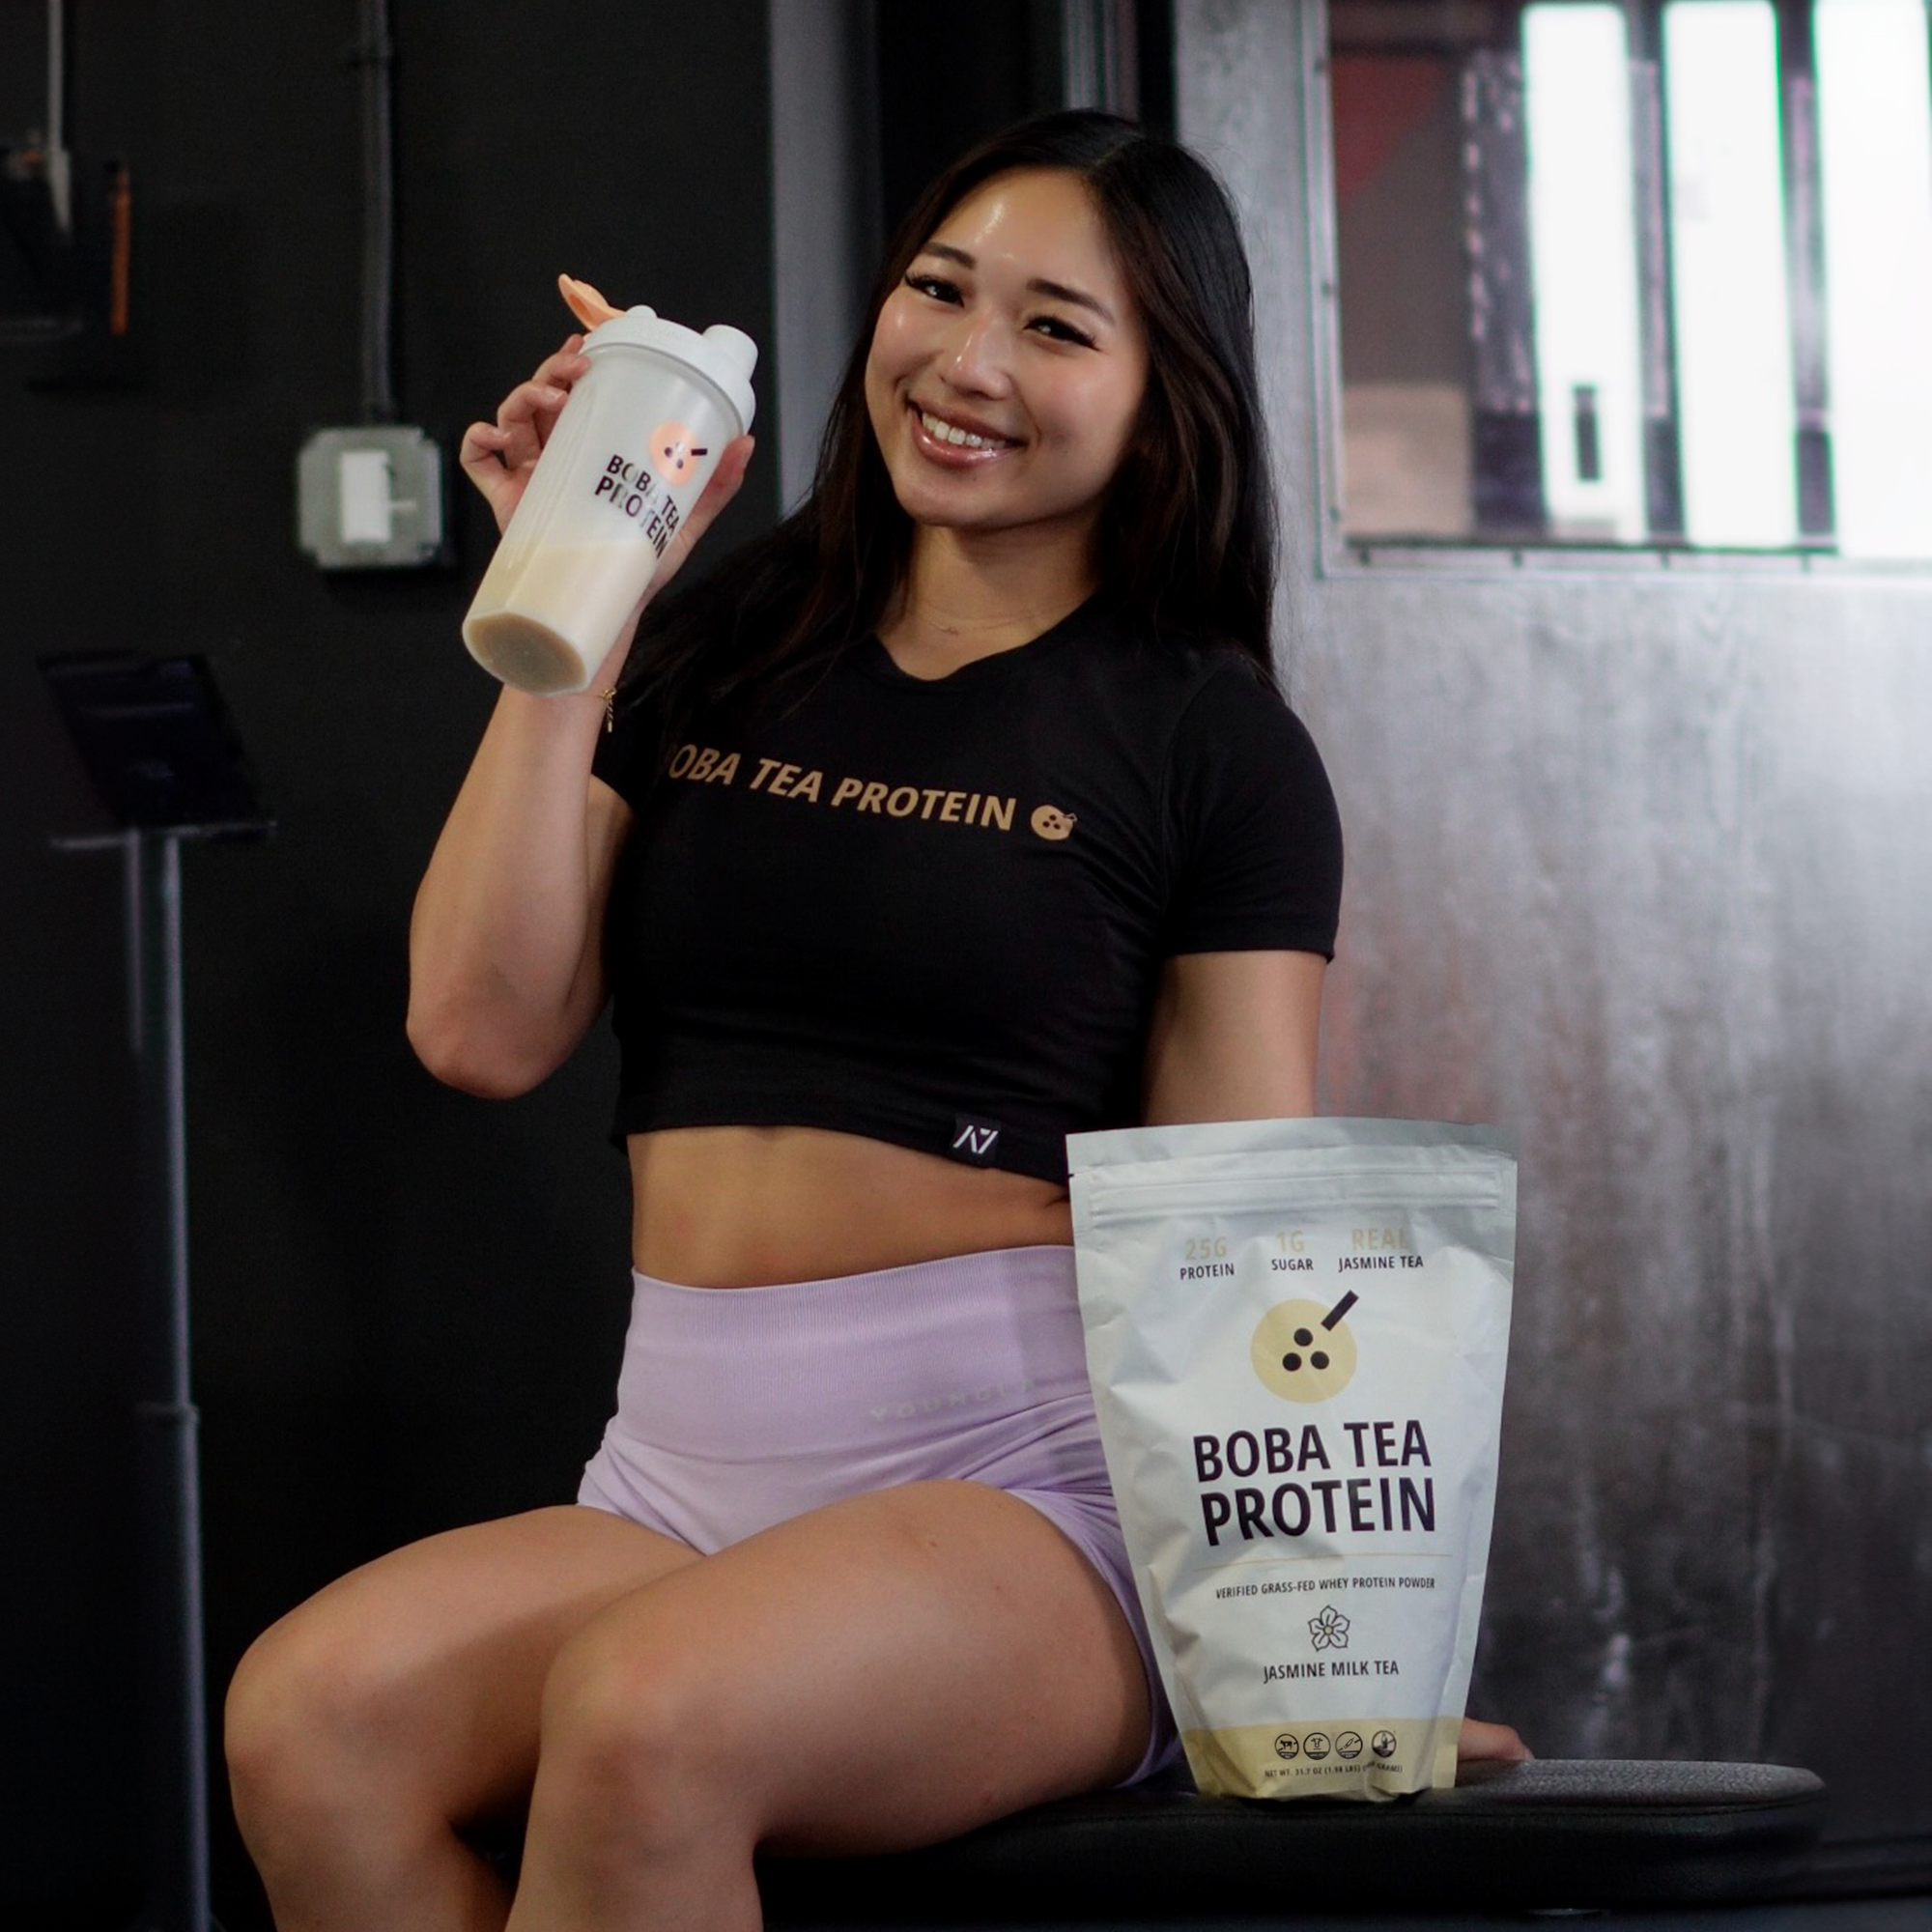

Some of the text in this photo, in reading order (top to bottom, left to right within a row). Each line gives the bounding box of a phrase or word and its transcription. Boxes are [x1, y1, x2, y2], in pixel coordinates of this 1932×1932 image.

[661, 495, 680, 537] TEA
[668, 744, 1017, 831] OBA TEA PROTEIN
[1185, 1236, 1227, 1261] 25G
[1276, 1231, 1303, 1252] 1G
[1352, 1228, 1408, 1251] REAL
[1179, 1264, 1235, 1280] PROTEIN
[1271, 1258, 1314, 1271] SUGAR
[1339, 1255, 1424, 1273] JASMINE TEA
[1193, 1419, 1432, 1483] BOBA TEA
[1200, 1477, 1435, 1547] PROTEIN
[1216, 1577, 1435, 1600] VERIFIED GRASS-FED WHEY PROTEIN POWDER
[1264, 1661, 1400, 1684] JASMINE MILK TEA
[1264, 1769, 1277, 1777] NET
[1313, 1765, 1322, 1775] OZ
